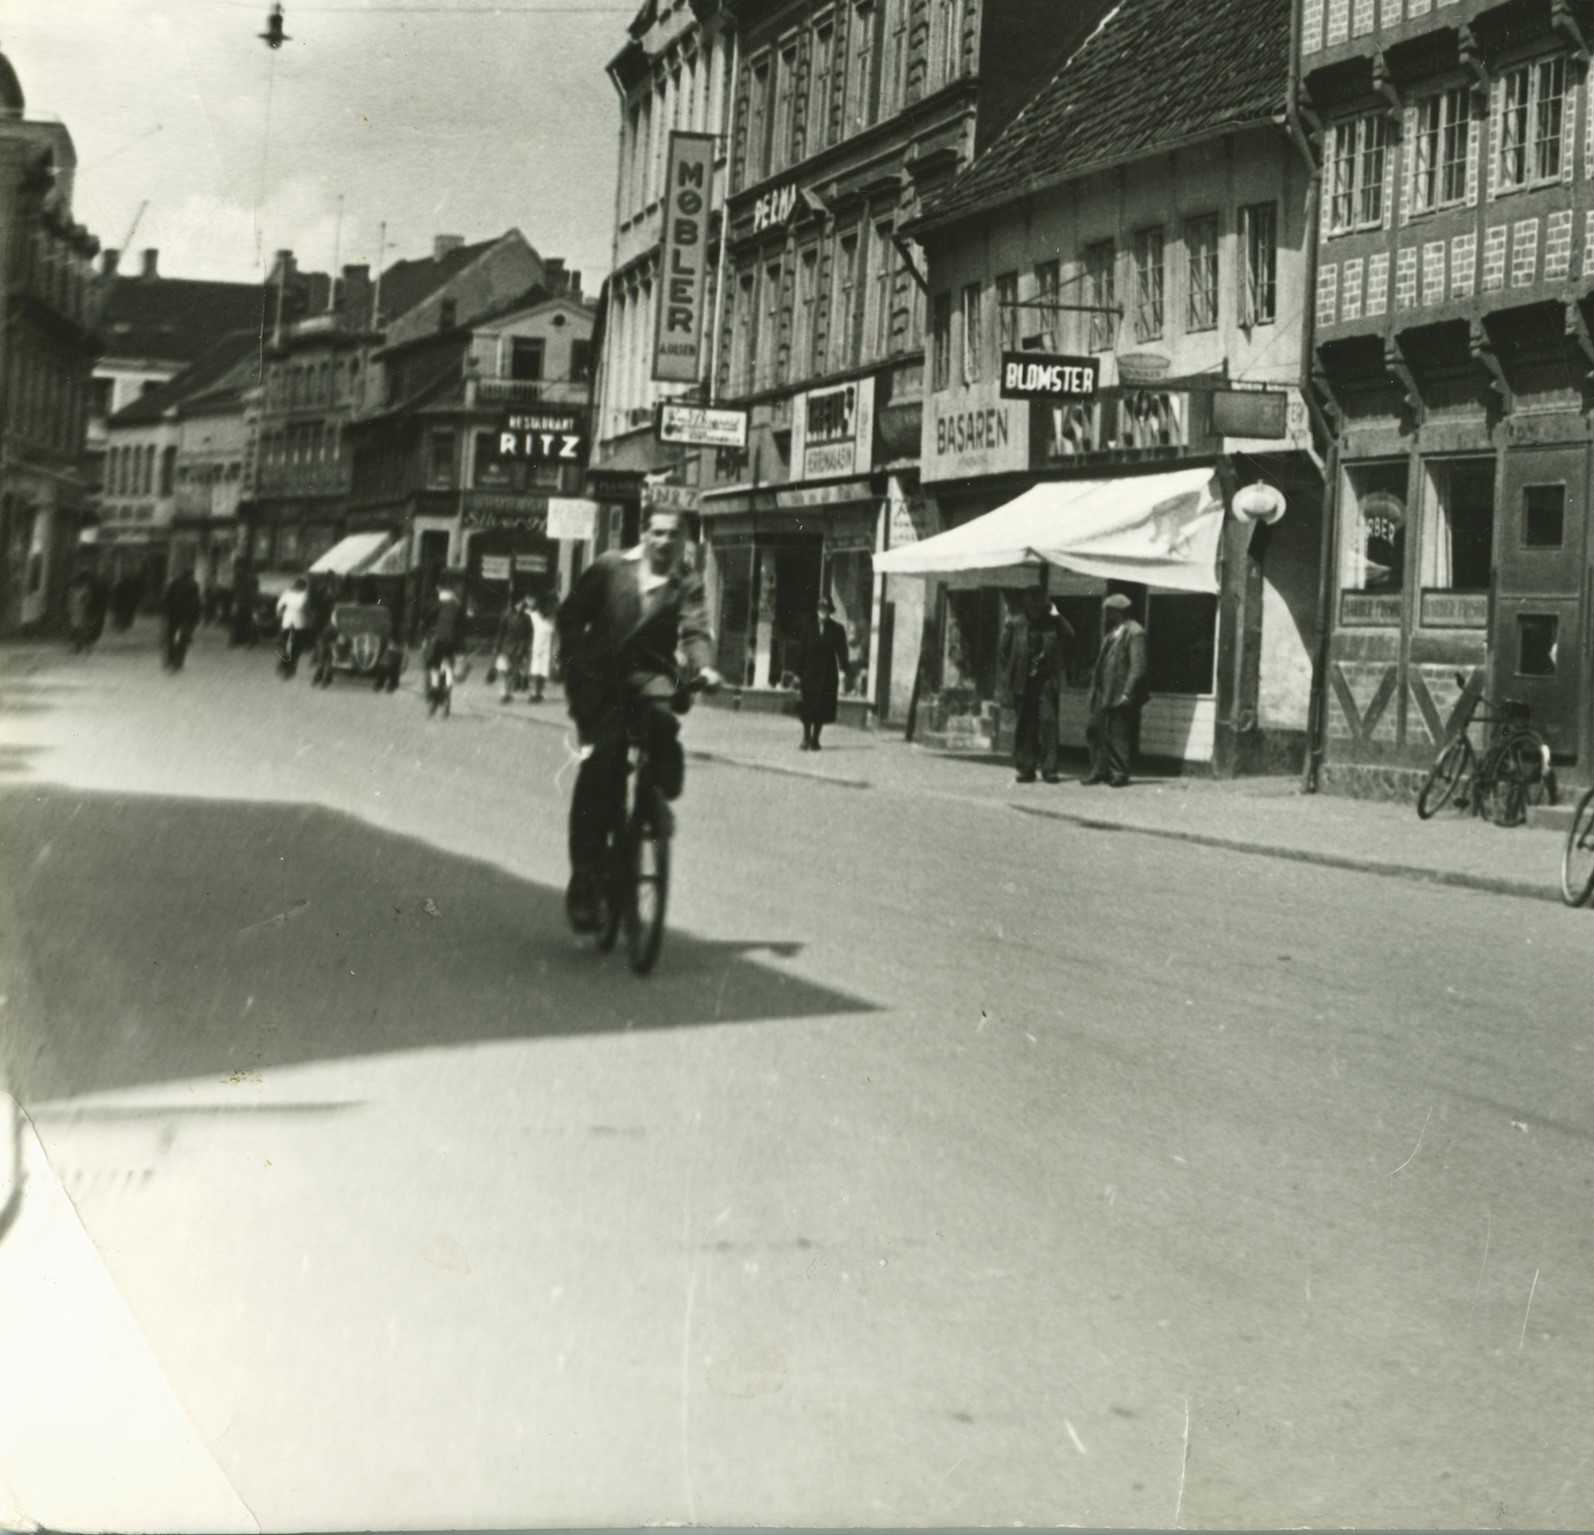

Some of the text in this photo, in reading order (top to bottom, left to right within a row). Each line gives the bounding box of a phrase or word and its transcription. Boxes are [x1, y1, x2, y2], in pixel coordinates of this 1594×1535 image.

[667, 161, 704, 333] MØBLER
[1005, 362, 1095, 394] BLOMSTER
[500, 432, 580, 458] RITZ
[936, 408, 1009, 456] BASAREN
